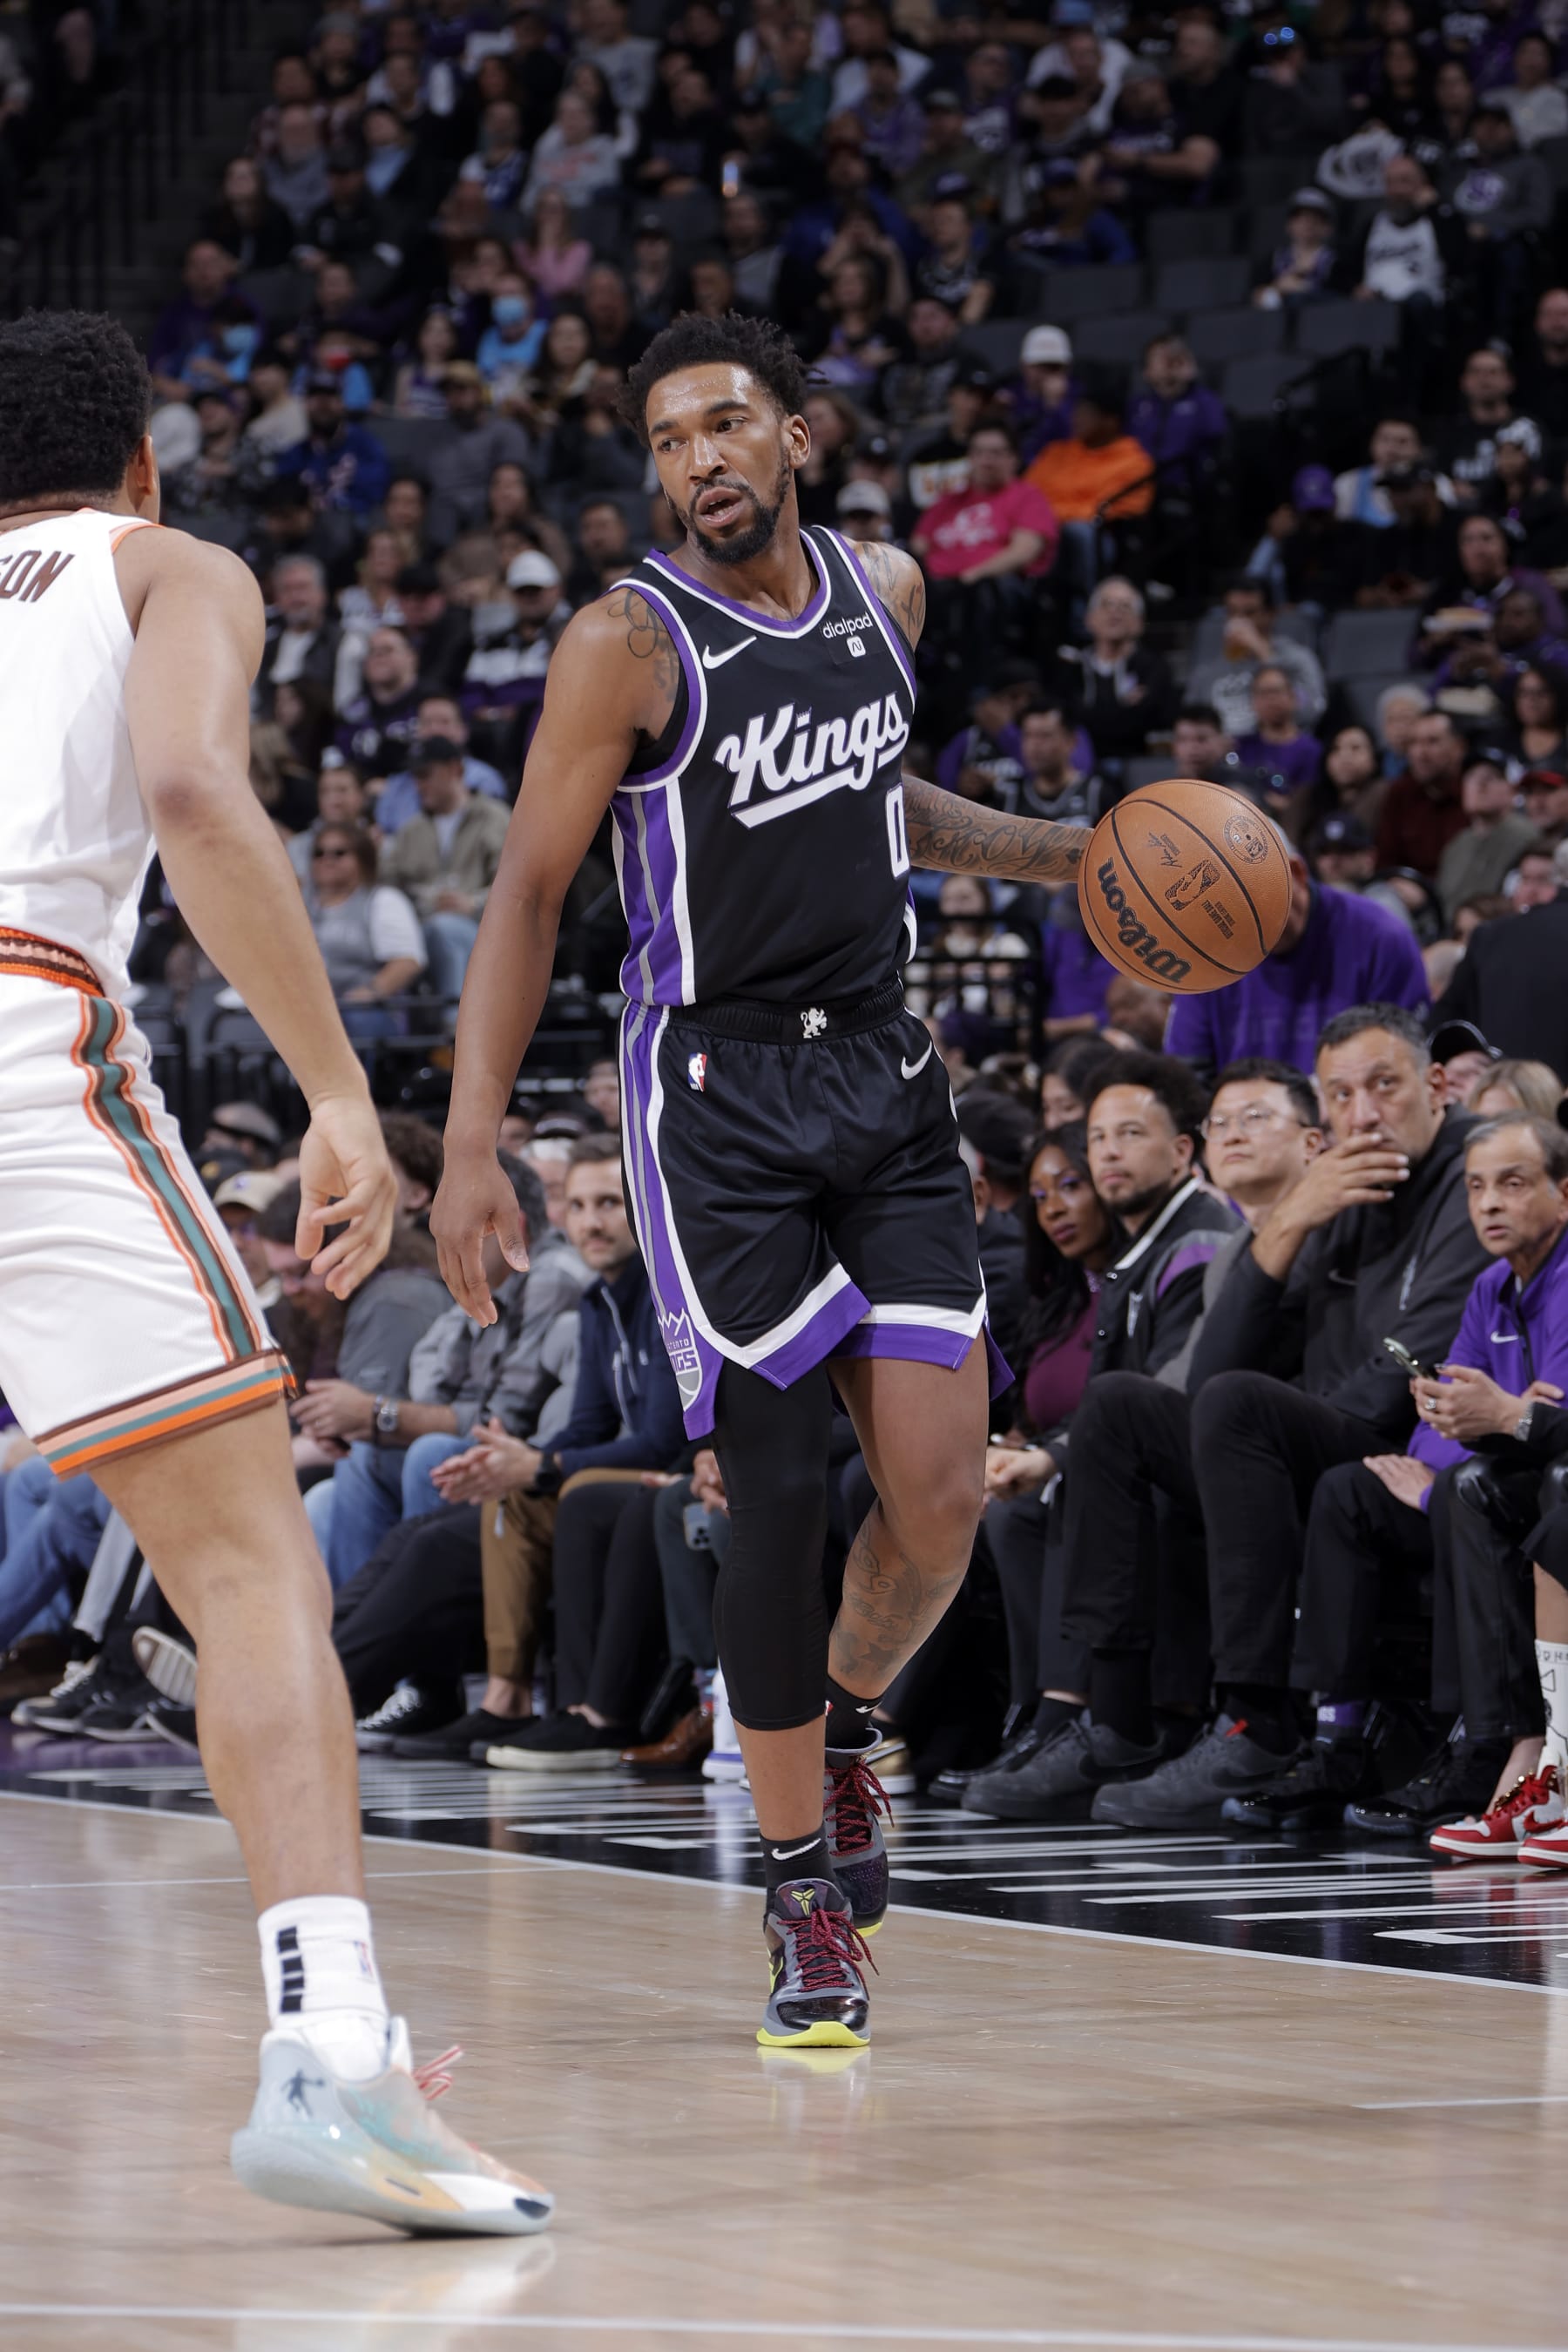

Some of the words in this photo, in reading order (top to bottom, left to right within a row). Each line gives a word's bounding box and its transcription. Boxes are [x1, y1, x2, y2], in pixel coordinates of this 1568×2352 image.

[822, 611, 874, 639] dialpad
[713, 692, 909, 830] Kings
[885, 782, 910, 879] 0
[1097, 856, 1193, 983] Wilson
